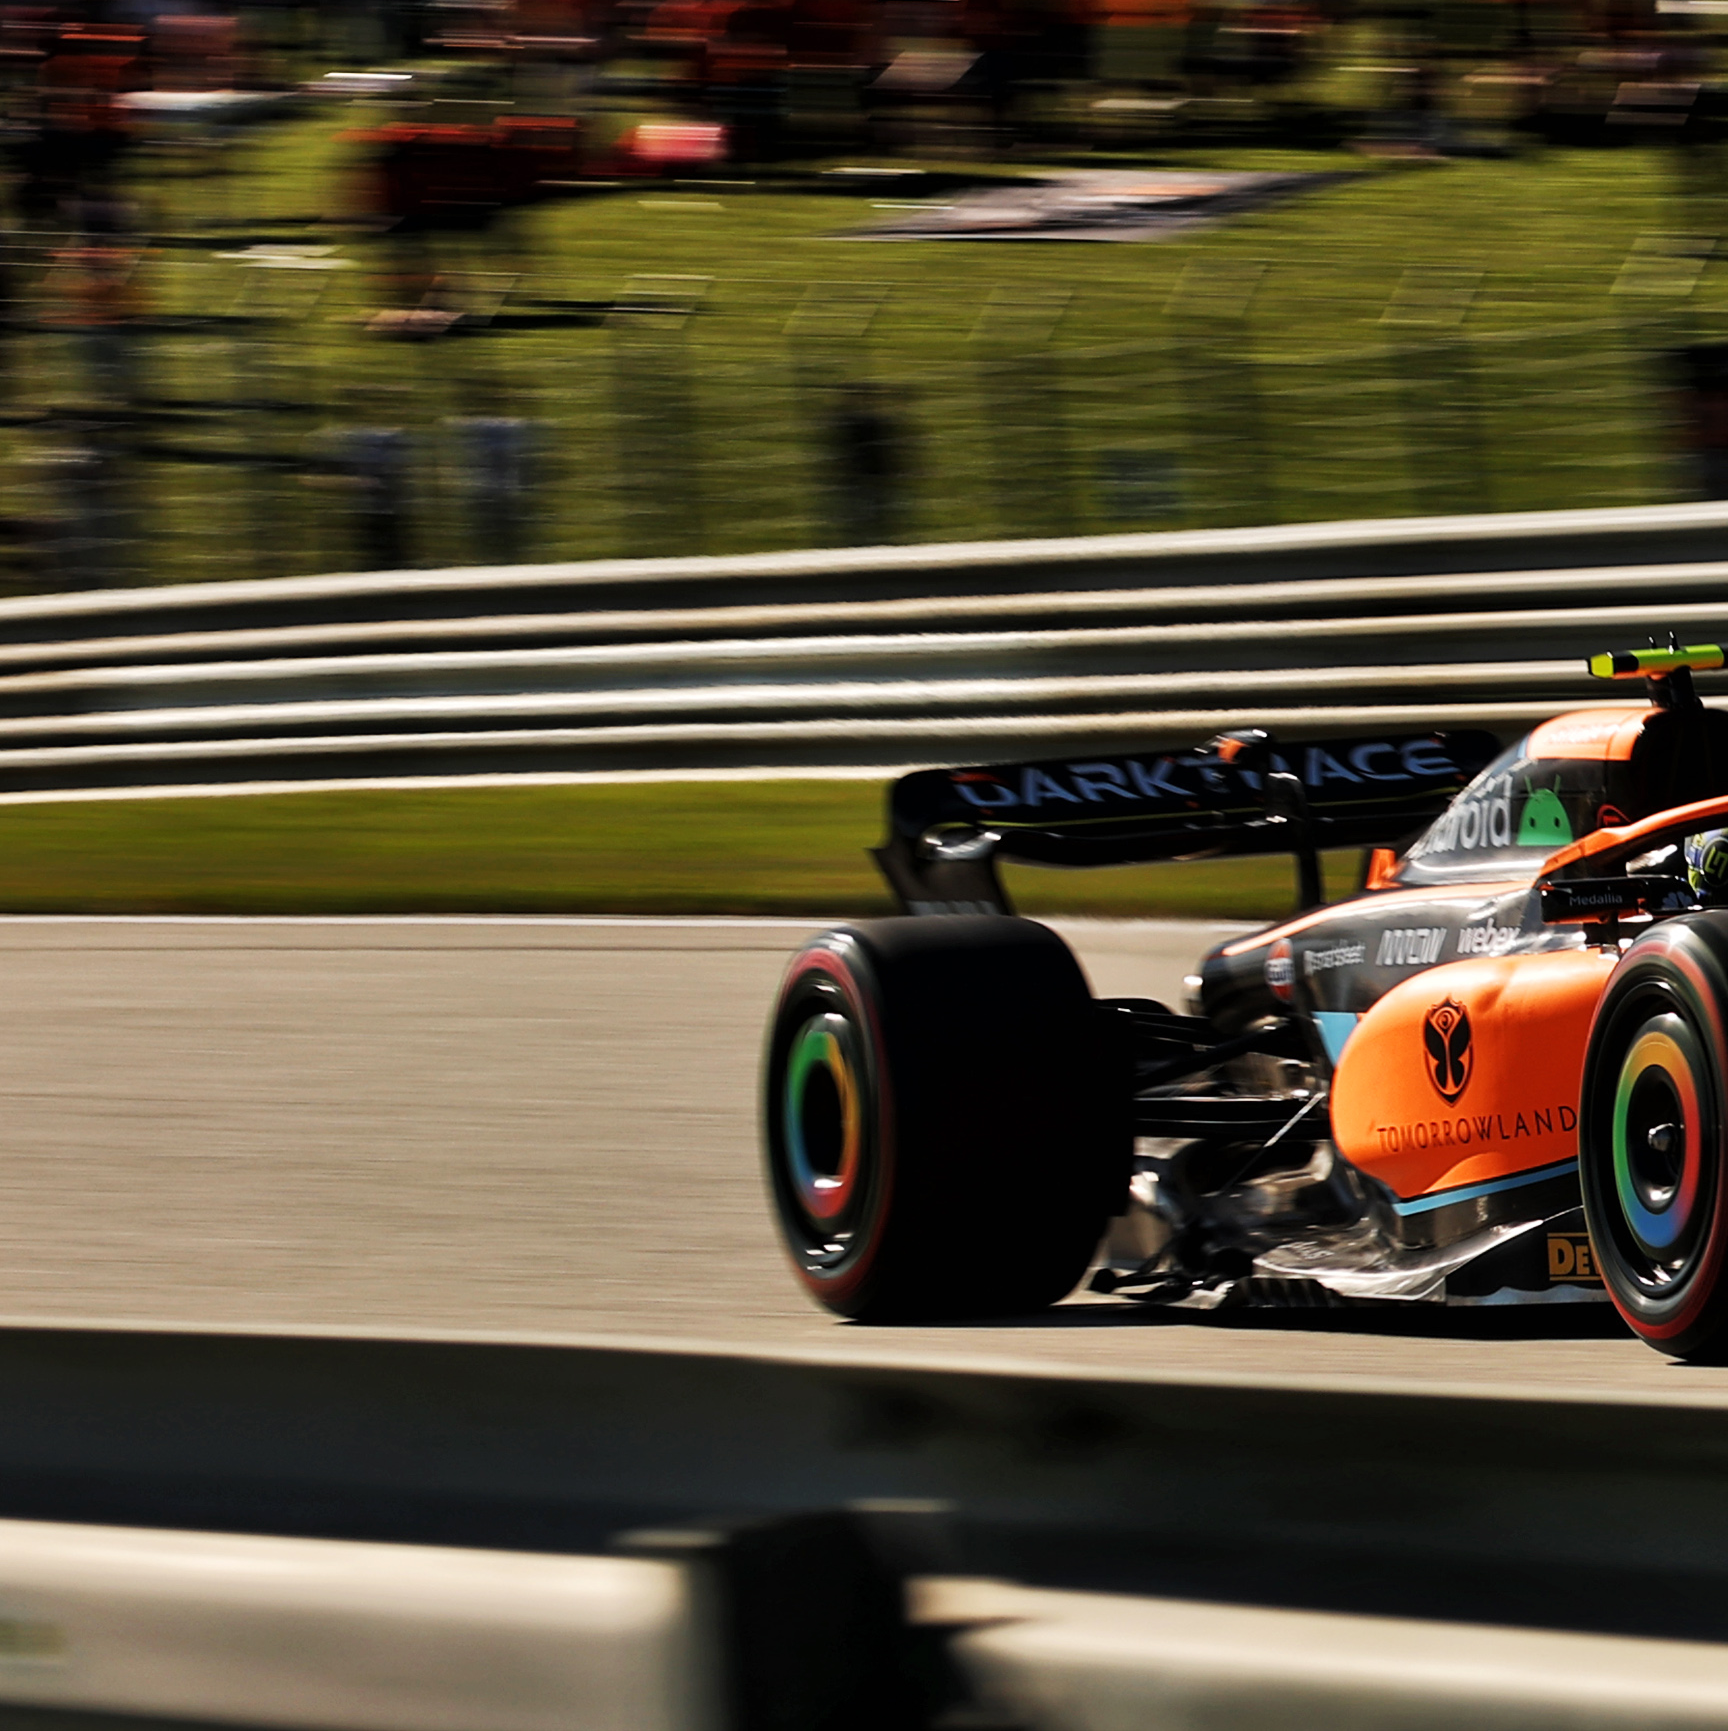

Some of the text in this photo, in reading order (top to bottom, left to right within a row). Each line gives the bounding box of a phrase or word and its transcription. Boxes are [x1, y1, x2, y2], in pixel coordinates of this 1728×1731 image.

[1568, 885, 1624, 907] Medallia
[1377, 1105, 1578, 1154] TOMORROWLAND
[1547, 1237, 1602, 1276] DE
